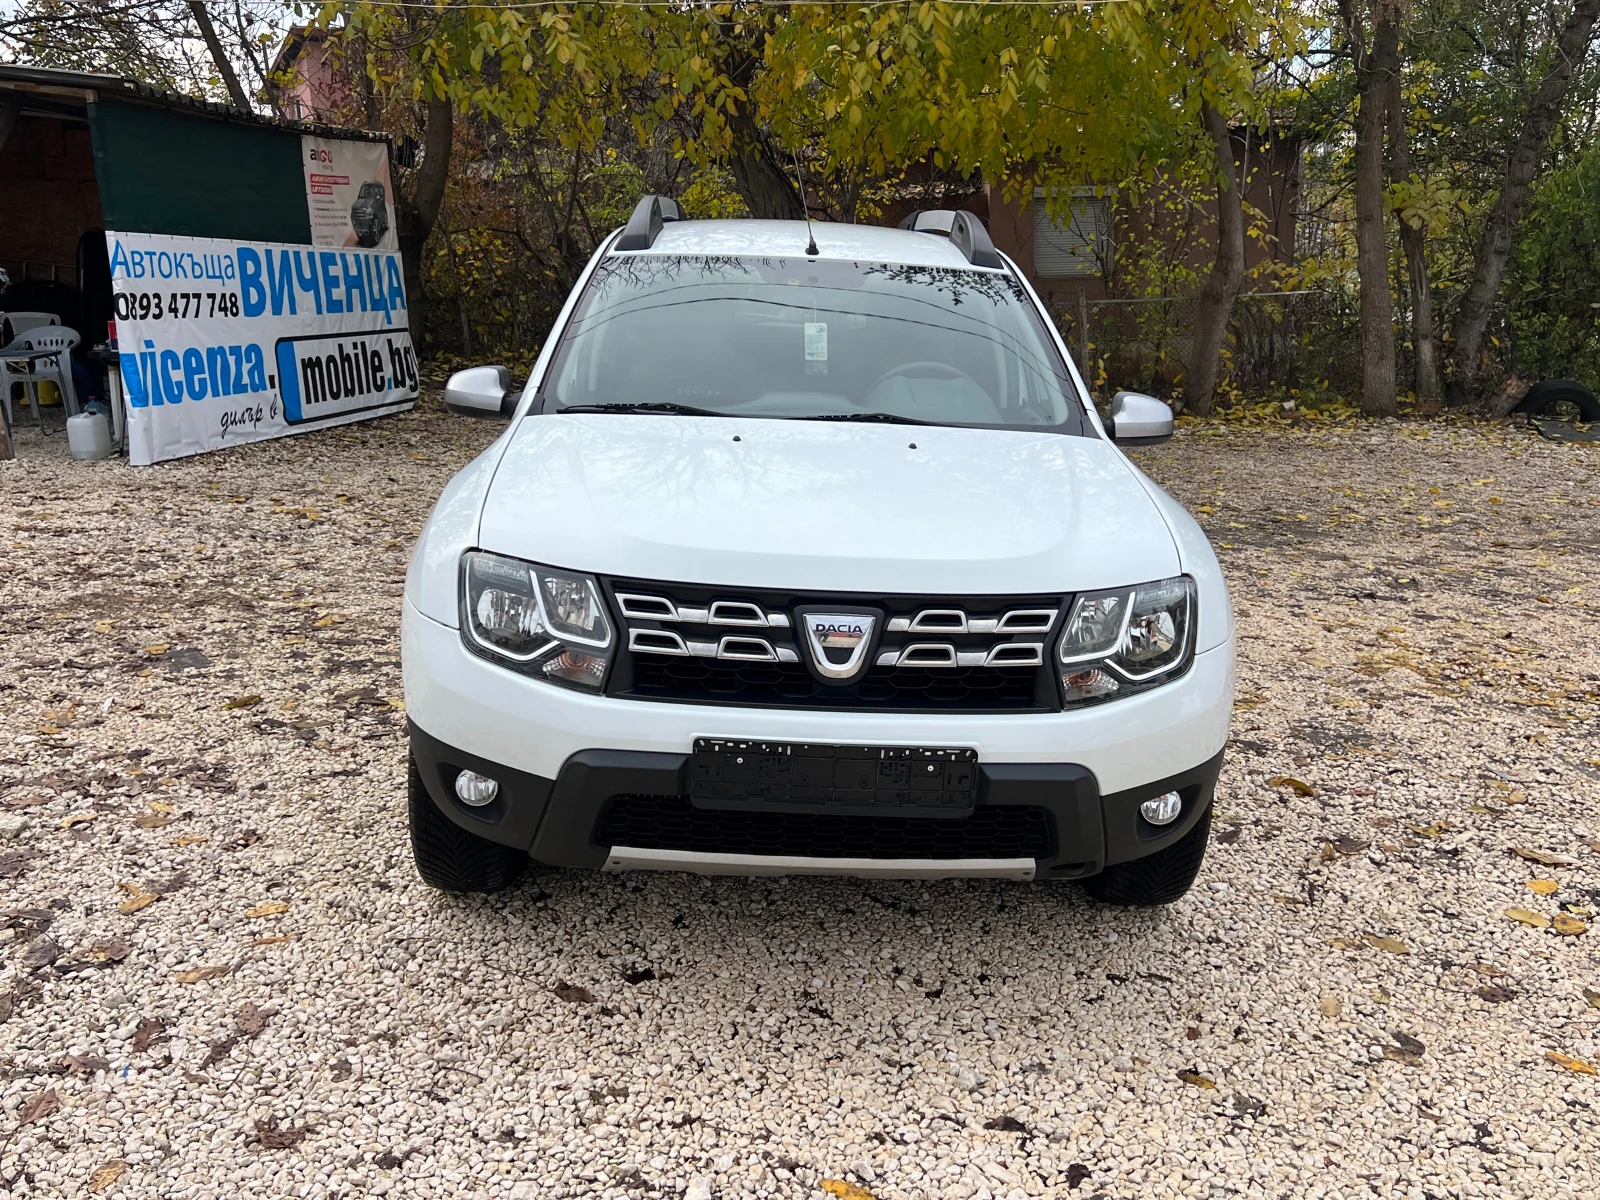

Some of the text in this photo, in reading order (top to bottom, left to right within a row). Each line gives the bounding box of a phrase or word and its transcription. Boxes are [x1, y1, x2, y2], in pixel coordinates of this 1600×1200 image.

[110, 239, 407, 325] Автокъща ВИЧЕНЦА
[113, 292, 240, 321] 0893 477 748
[300, 338, 419, 405] mobile.bg
[220, 403, 265, 439] дилър
[815, 623, 863, 634] DACIA
